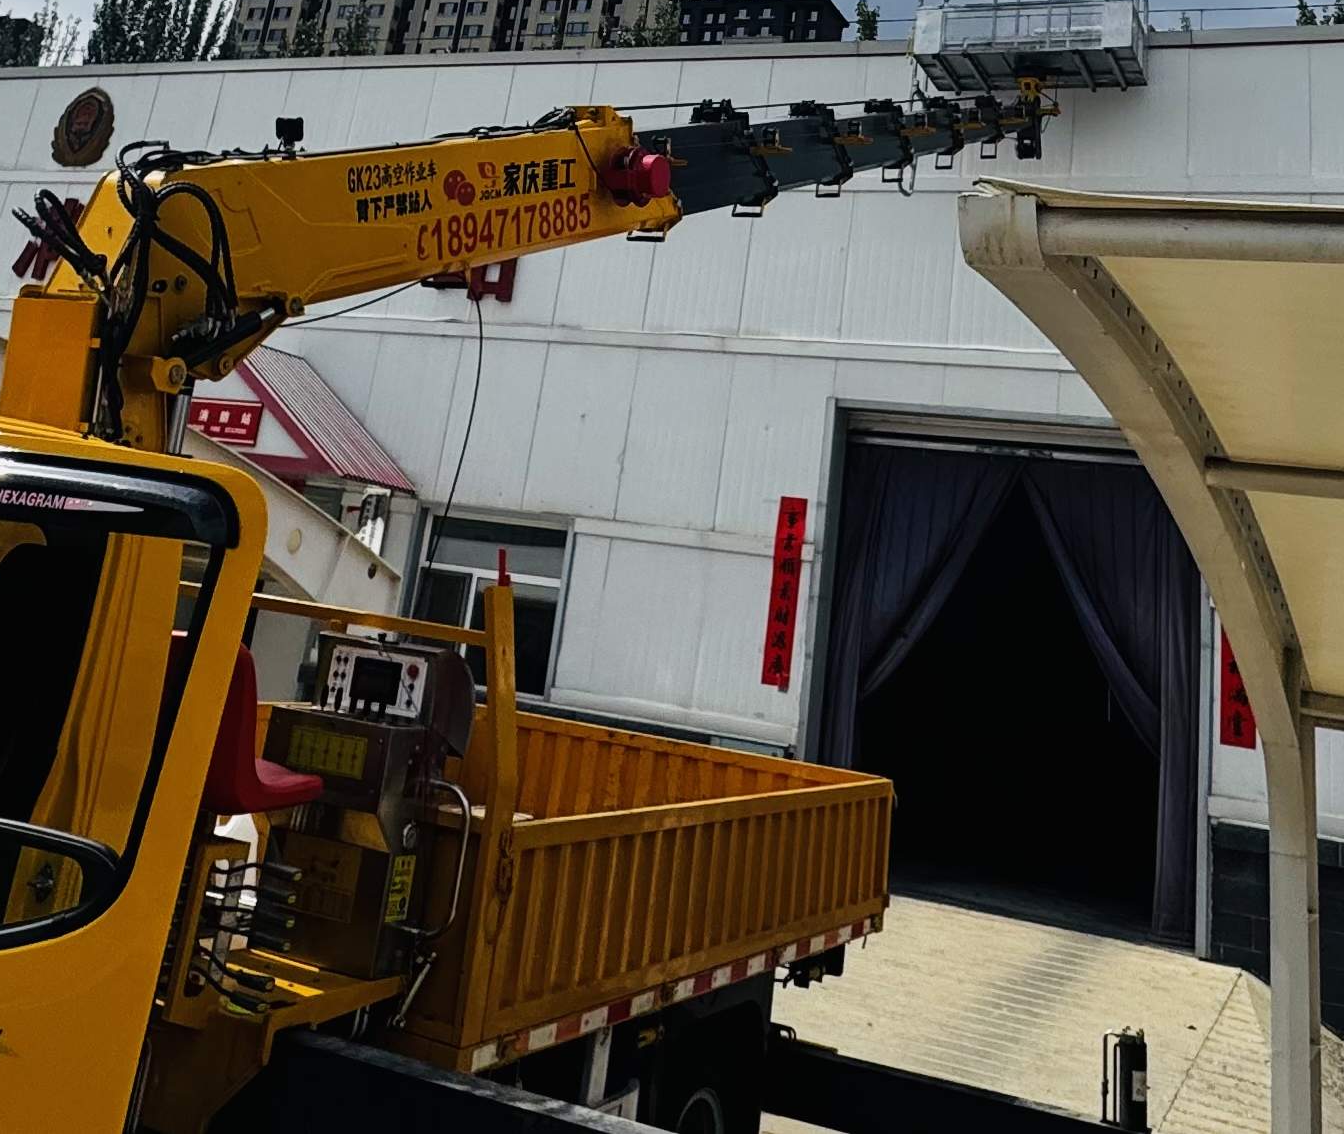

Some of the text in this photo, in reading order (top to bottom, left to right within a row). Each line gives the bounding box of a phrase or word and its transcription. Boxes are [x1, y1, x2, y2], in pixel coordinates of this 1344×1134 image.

[347, 159, 437, 194] GK23高空作业车
[503, 158, 577, 197] 家庆重工
[356, 189, 433, 224] 臂下严禁站人
[431, 192, 591, 261] 18947178885
